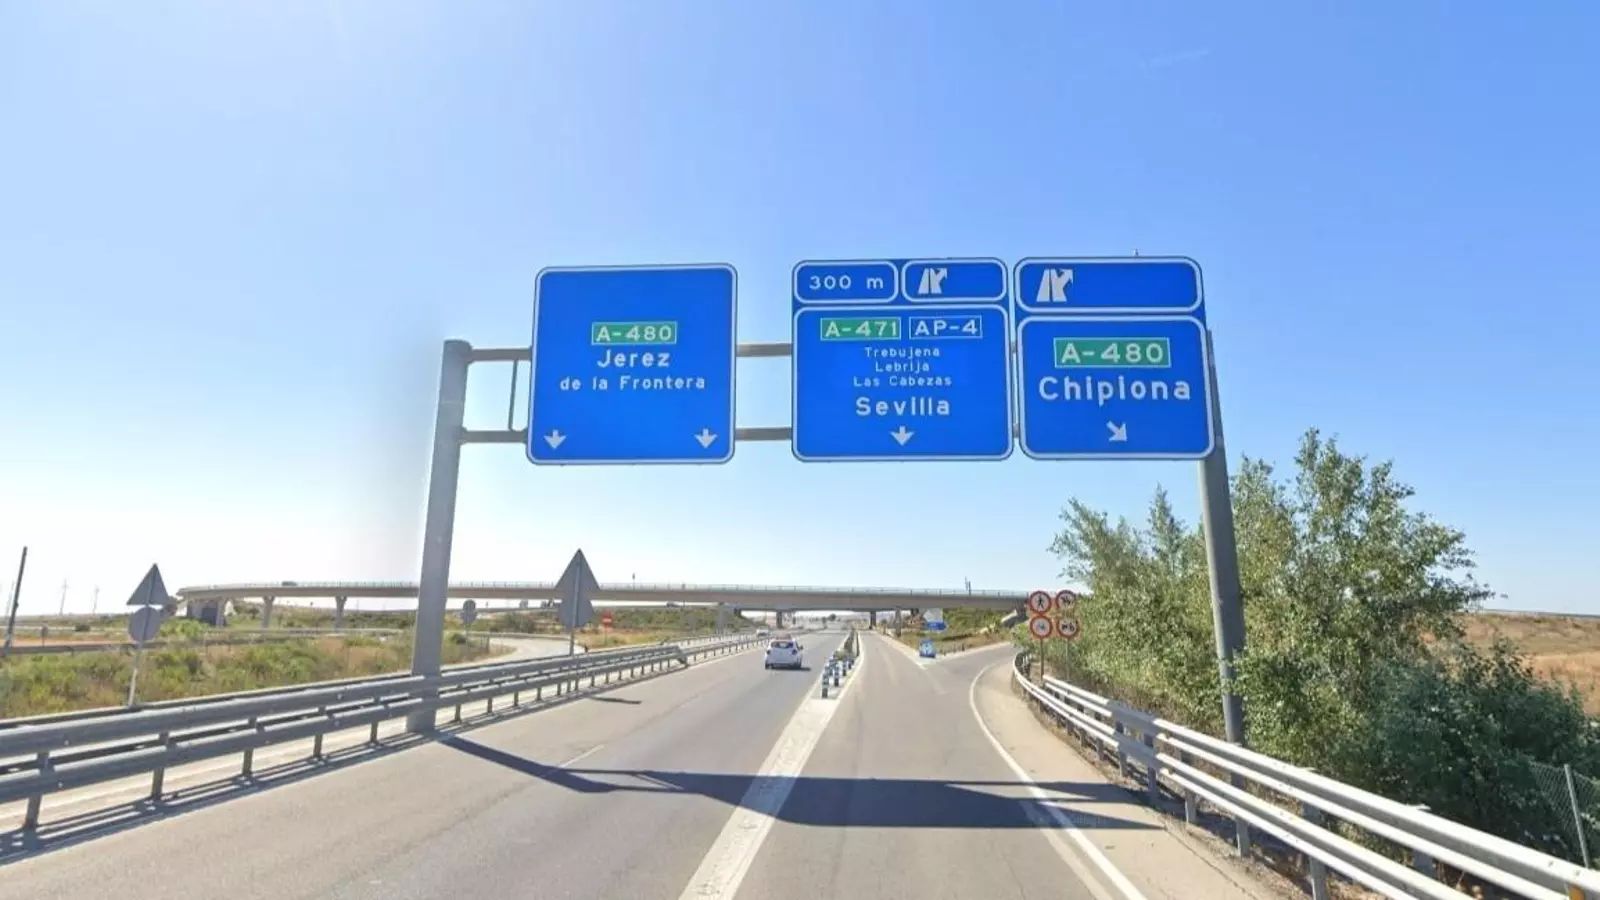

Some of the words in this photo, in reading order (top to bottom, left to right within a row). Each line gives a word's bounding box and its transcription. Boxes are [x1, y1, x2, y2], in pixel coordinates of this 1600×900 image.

[809, 275, 852, 290] 300
[866, 277, 884, 290] m
[596, 325, 672, 342] A-480
[825, 320, 898, 337] A-471
[914, 319, 978, 336] AP-4
[597, 349, 671, 368] Jerez
[864, 346, 940, 359] Trebujena
[1061, 342, 1164, 364] A-480
[875, 360, 930, 374] Lebrija
[559, 376, 582, 391] de
[592, 376, 608, 391] la
[620, 375, 706, 391] Frontera
[853, 376, 880, 388] Las
[889, 375, 952, 387] Cabezas
[1038, 375, 1191, 407] Chipiona
[855, 396, 951, 417] Sevilla
